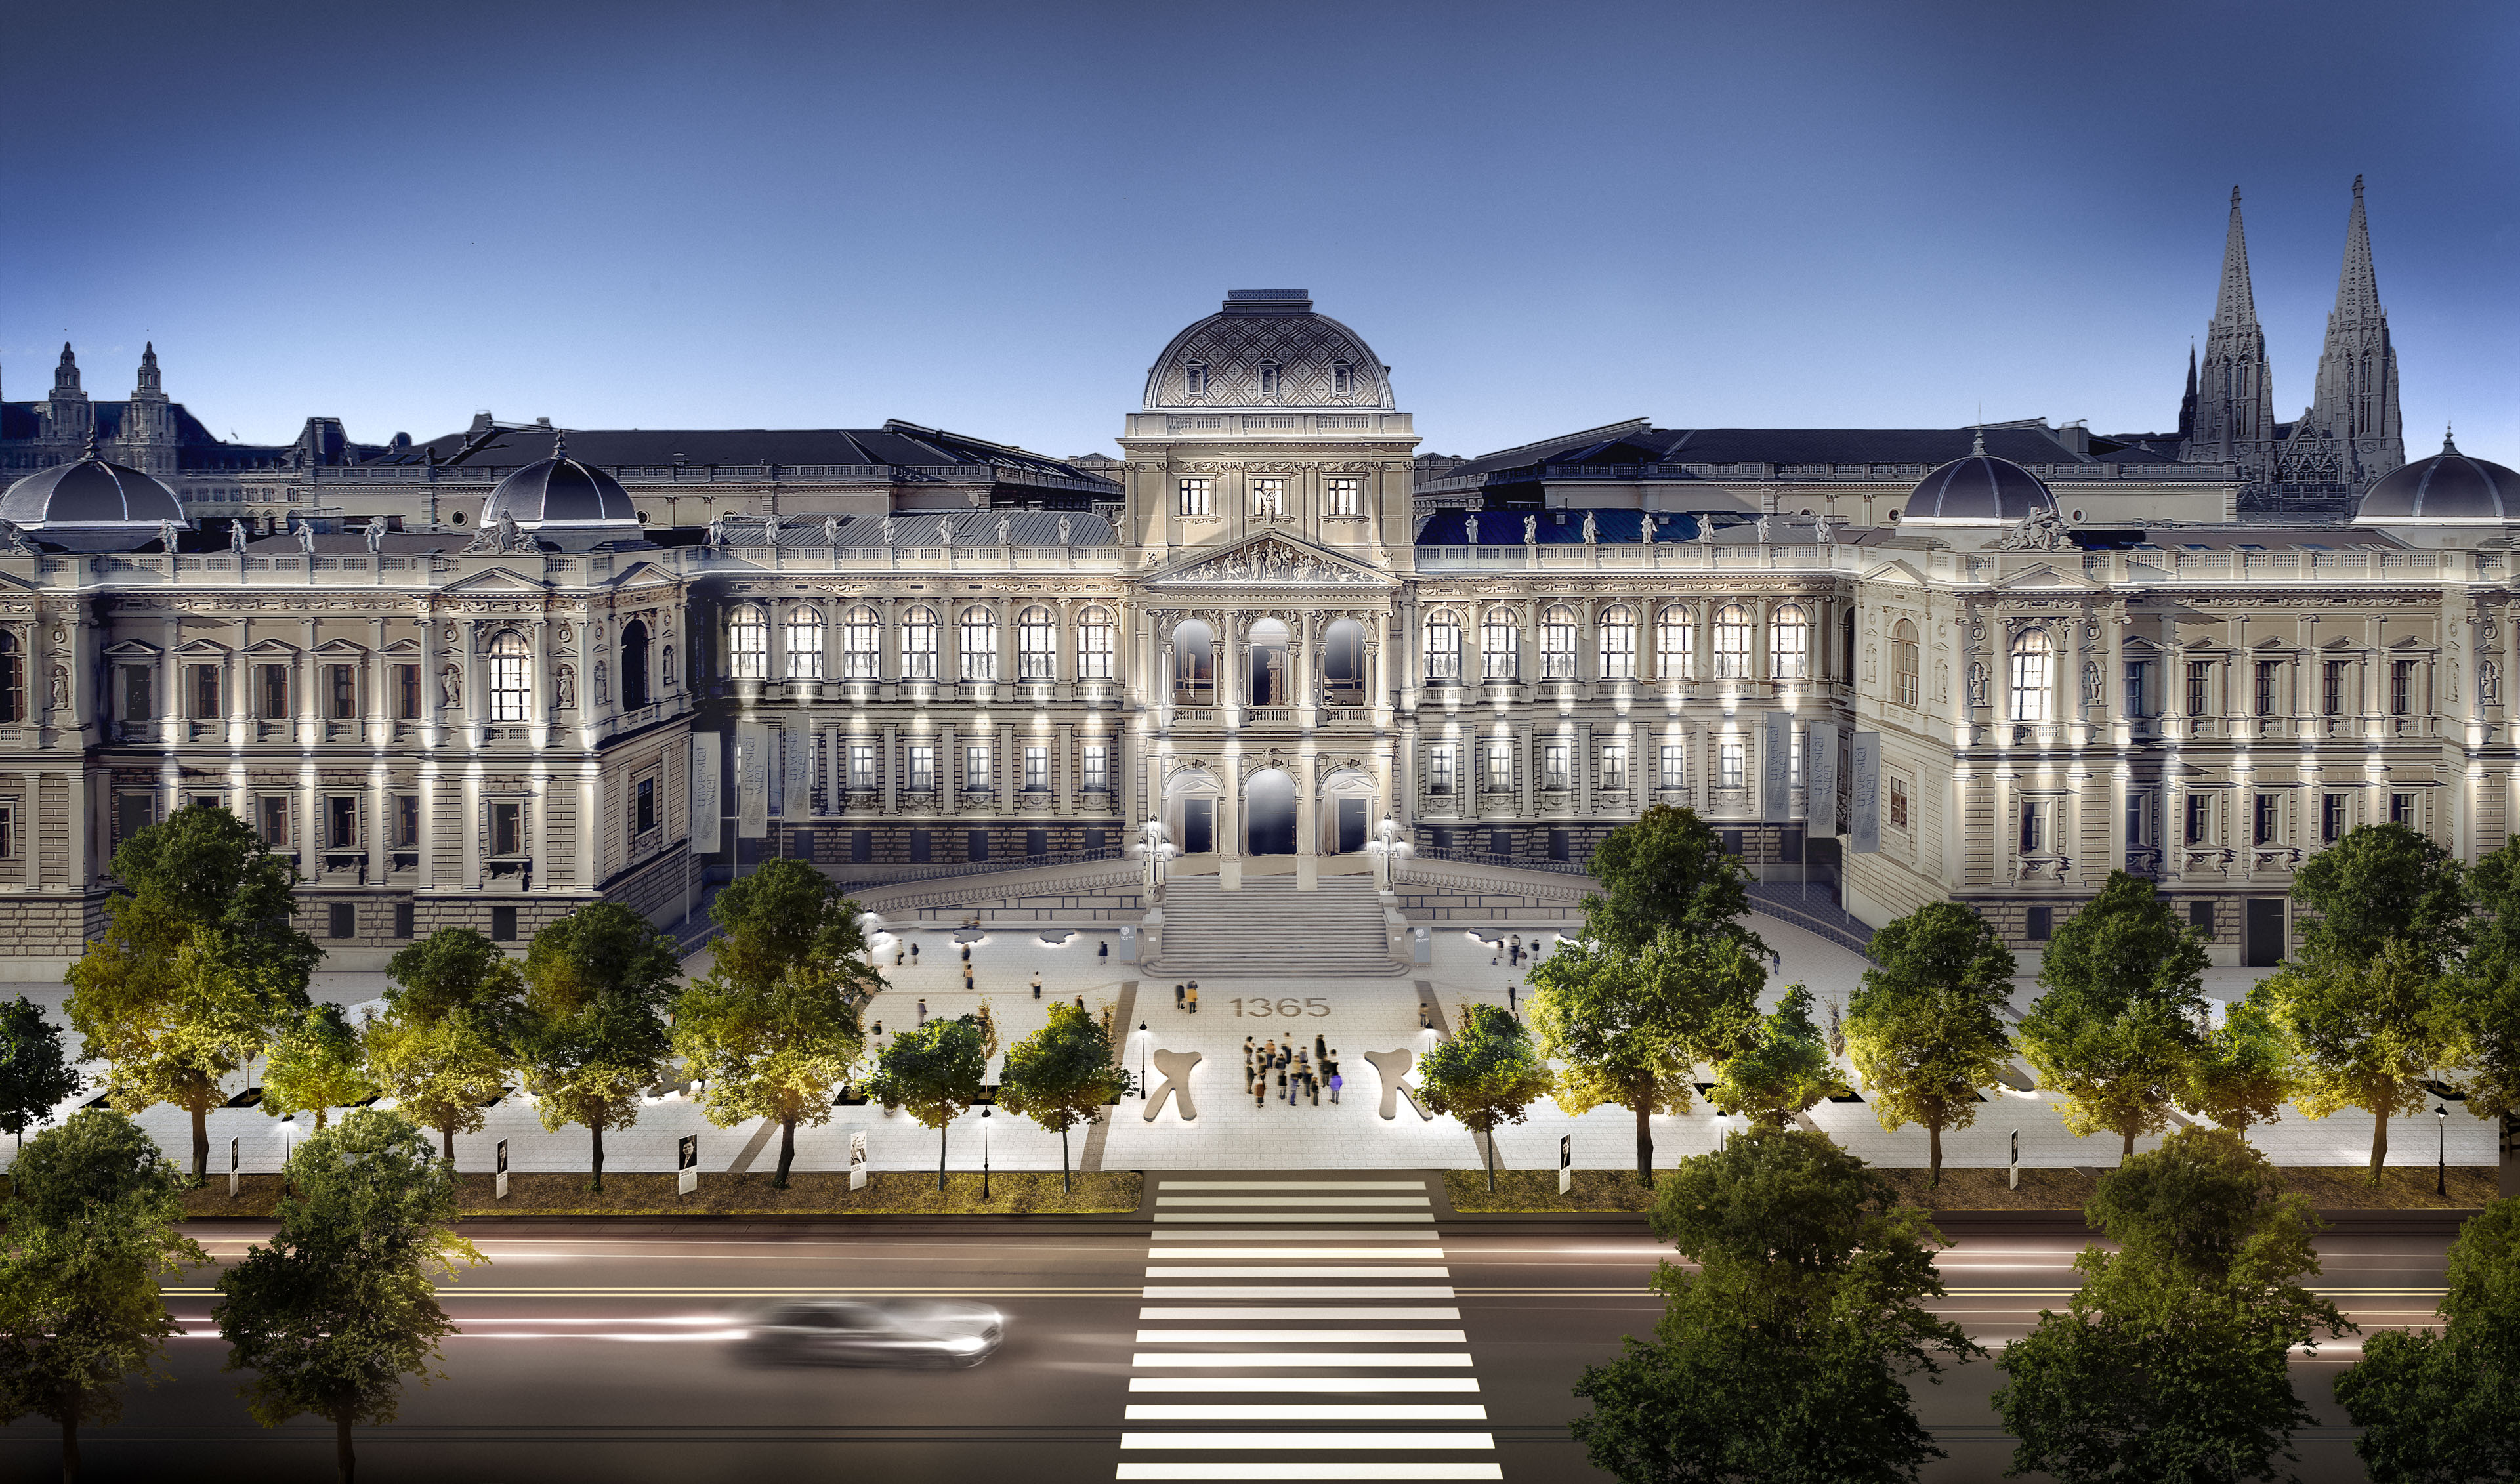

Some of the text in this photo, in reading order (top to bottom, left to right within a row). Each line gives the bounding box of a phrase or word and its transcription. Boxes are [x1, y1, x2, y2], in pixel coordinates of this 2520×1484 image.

[742, 736, 755, 795] universität
[787, 725, 798, 781] universität
[797, 752, 807, 780] wien
[1767, 725, 1778, 780] universität
[1778, 752, 1787, 780] wien
[1811, 736, 1824, 795] universität
[695, 747, 707, 807] universität
[707, 774, 716, 806] wien
[755, 765, 764, 794] wien
[1824, 765, 1833, 794] wien
[1854, 746, 1866, 807] universität
[1866, 774, 1876, 805] wien
[1229, 998, 1330, 1017] 1365
